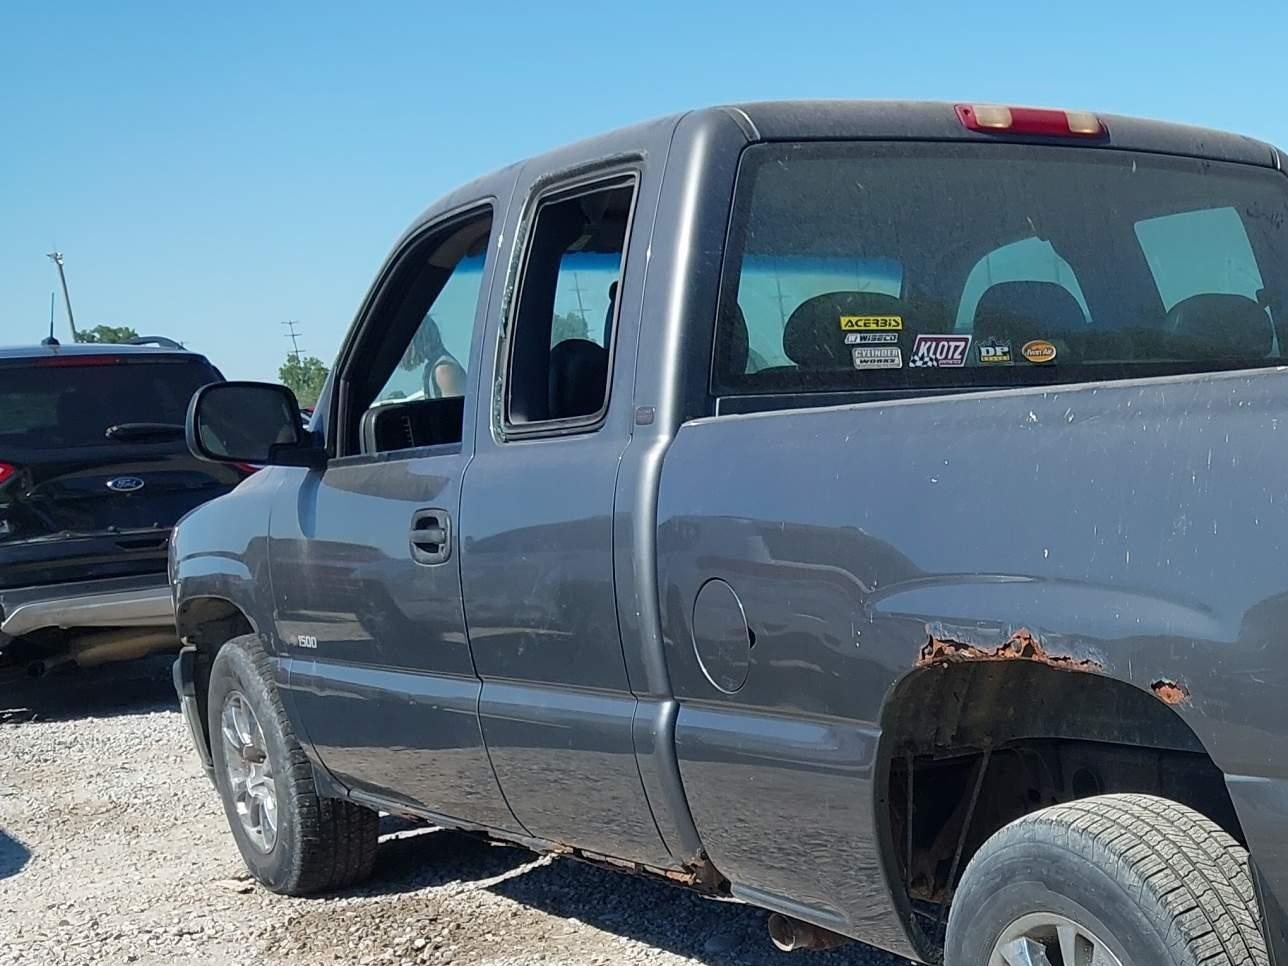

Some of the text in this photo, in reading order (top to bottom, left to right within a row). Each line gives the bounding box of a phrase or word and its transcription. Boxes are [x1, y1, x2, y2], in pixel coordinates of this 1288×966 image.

[844, 318, 900, 328] ACERBIS
[855, 349, 899, 357] CYLINDER
[918, 341, 966, 360] KLOTZ
[981, 346, 1009, 357] DP
[298, 635, 317, 649] 1500
